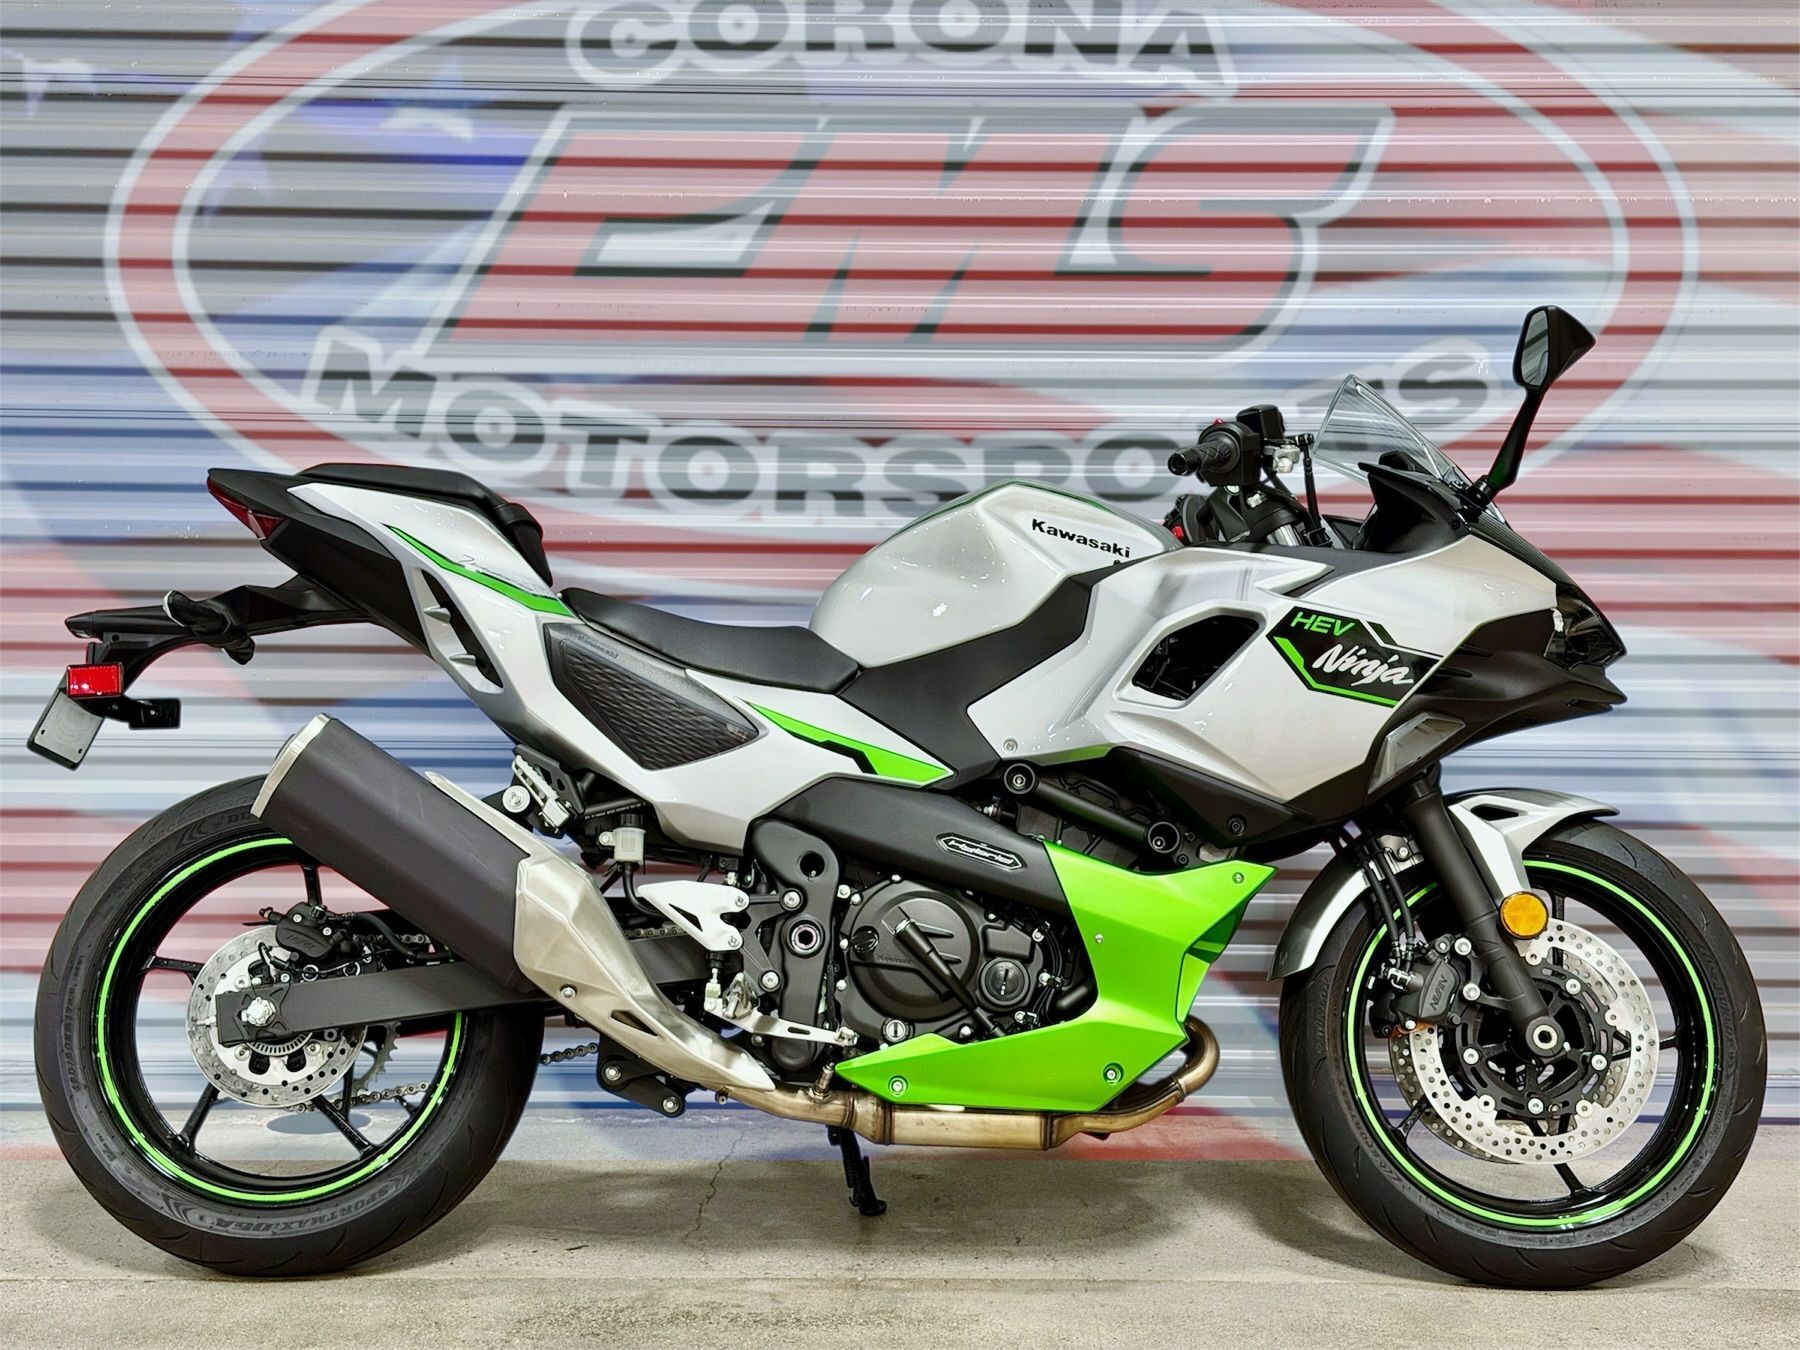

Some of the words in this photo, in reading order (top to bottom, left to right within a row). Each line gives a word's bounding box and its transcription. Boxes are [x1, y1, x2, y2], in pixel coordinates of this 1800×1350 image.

[572, 0, 1233, 90] CORONA
[310, 337, 1490, 517] MOTORSPOTS
[1031, 518, 1131, 558] Kawasaki
[1290, 611, 1355, 637] HEV
[1311, 643, 1414, 687] Ninja
